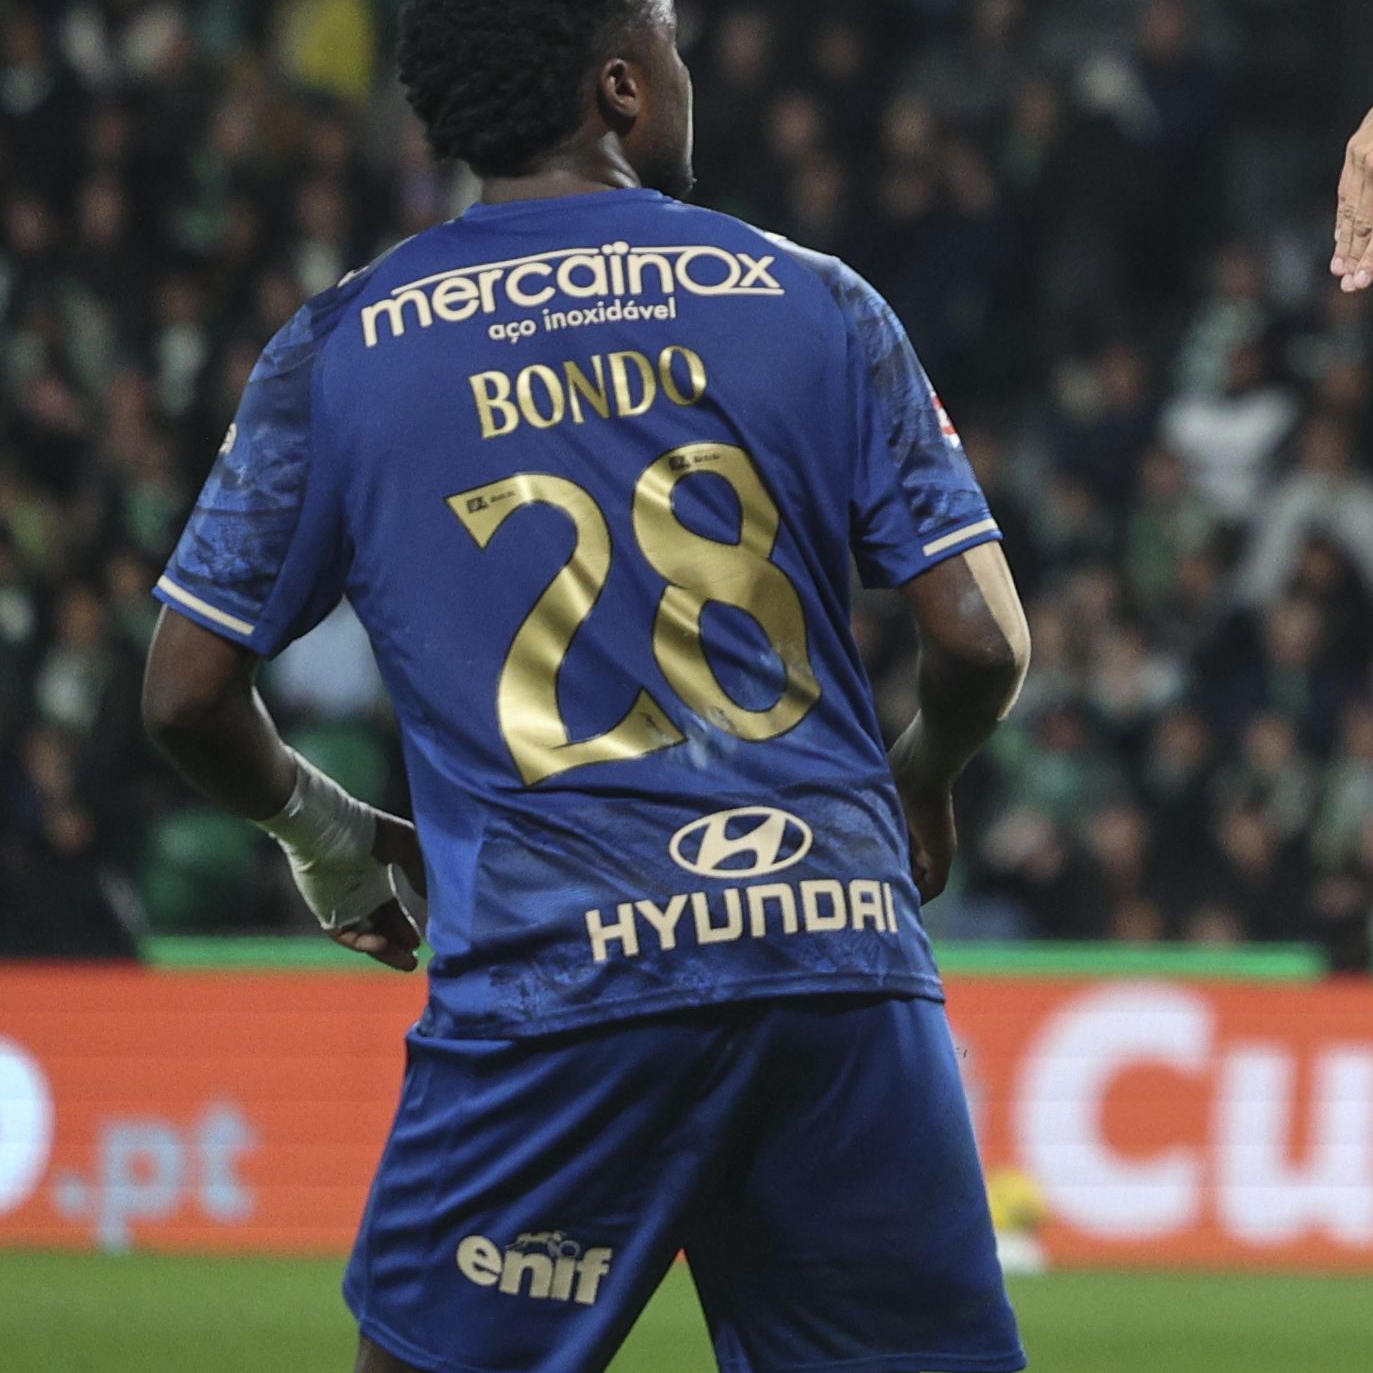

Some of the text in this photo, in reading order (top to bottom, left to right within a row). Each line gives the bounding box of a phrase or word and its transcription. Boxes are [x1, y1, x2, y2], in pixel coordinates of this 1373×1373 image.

[488, 296, 677, 344] aço inoxidável
[469, 344, 707, 440] BONDO
[443, 440, 823, 789] 28
[585, 878, 899, 963] HYUNDAI
[456, 1231, 613, 1306] enif
